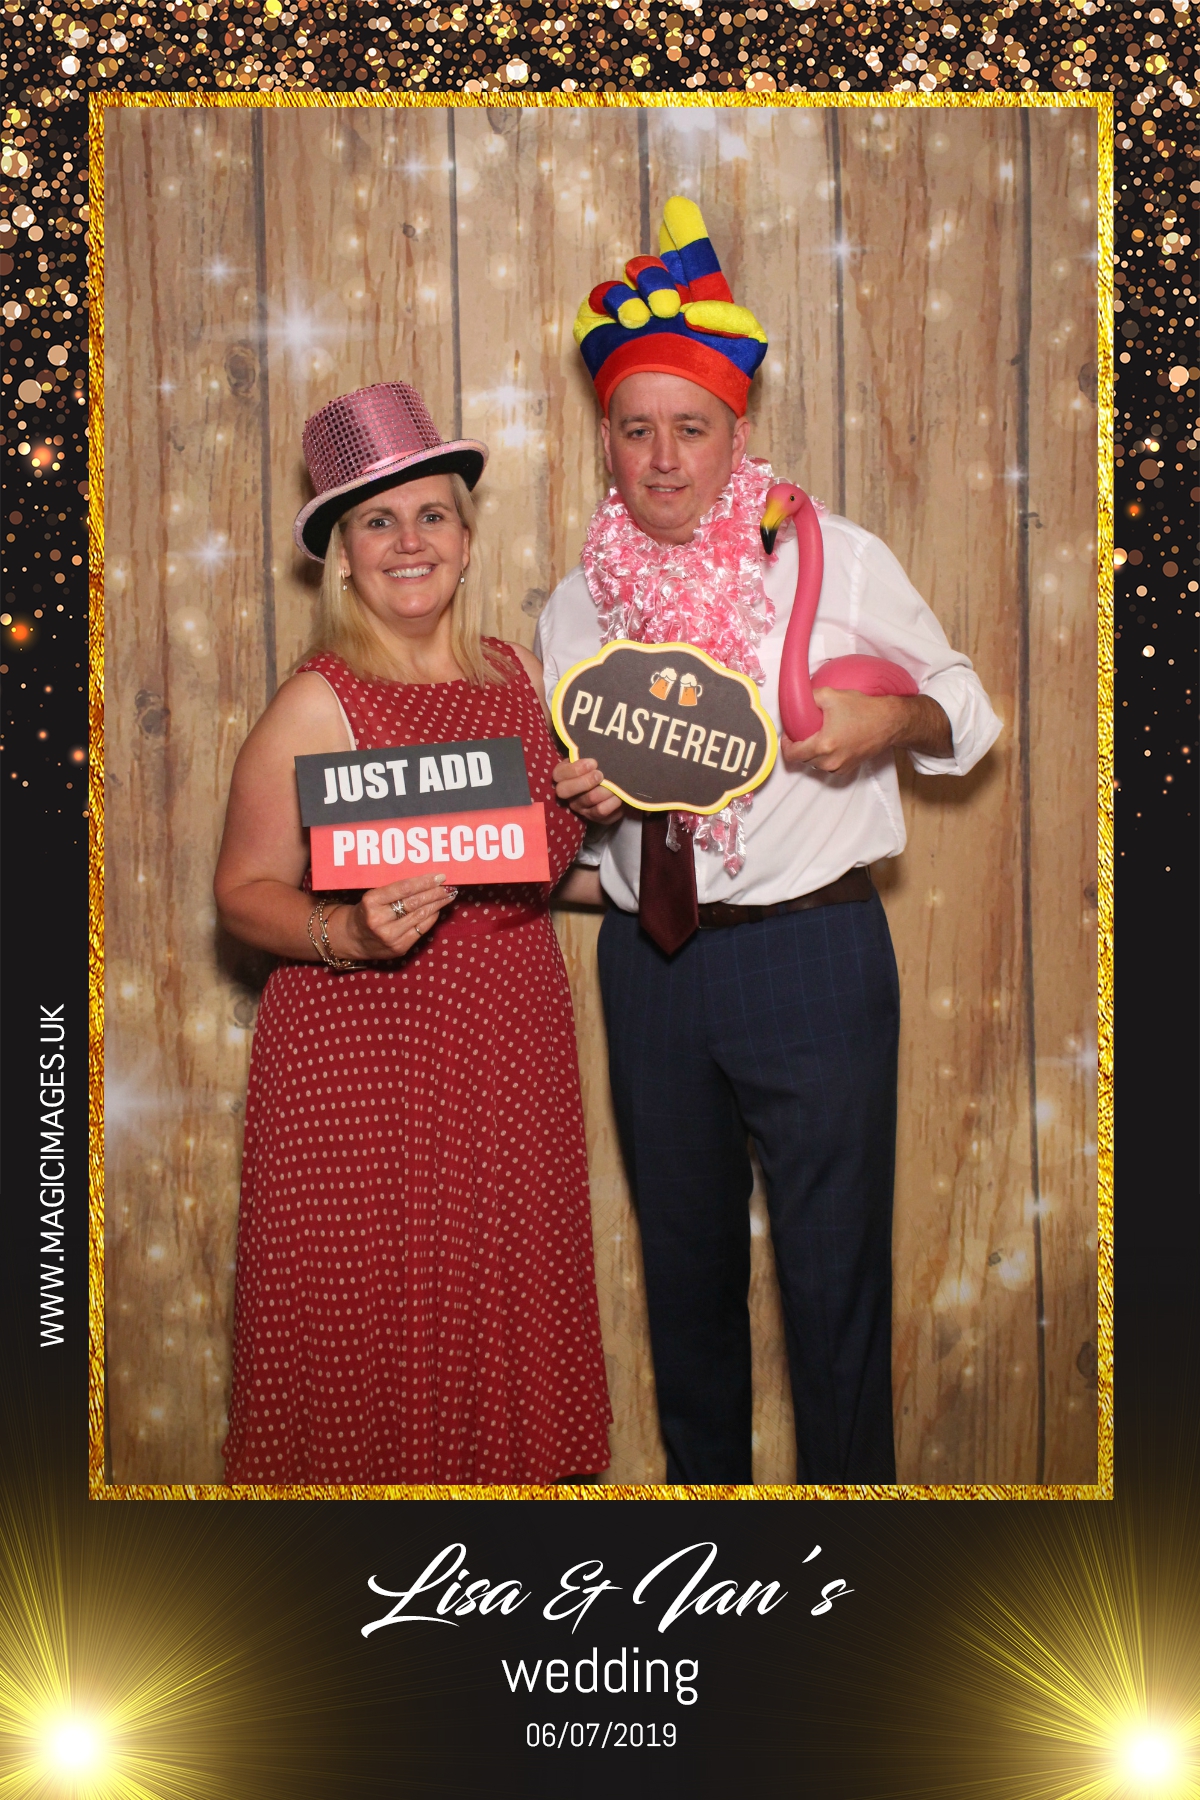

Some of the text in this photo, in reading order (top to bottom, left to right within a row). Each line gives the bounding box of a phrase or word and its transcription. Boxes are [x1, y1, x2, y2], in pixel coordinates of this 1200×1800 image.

[568, 690, 758, 777] PLASTERED!
[323, 751, 494, 805] JUST ADD
[332, 823, 525, 867] PROSECCO
